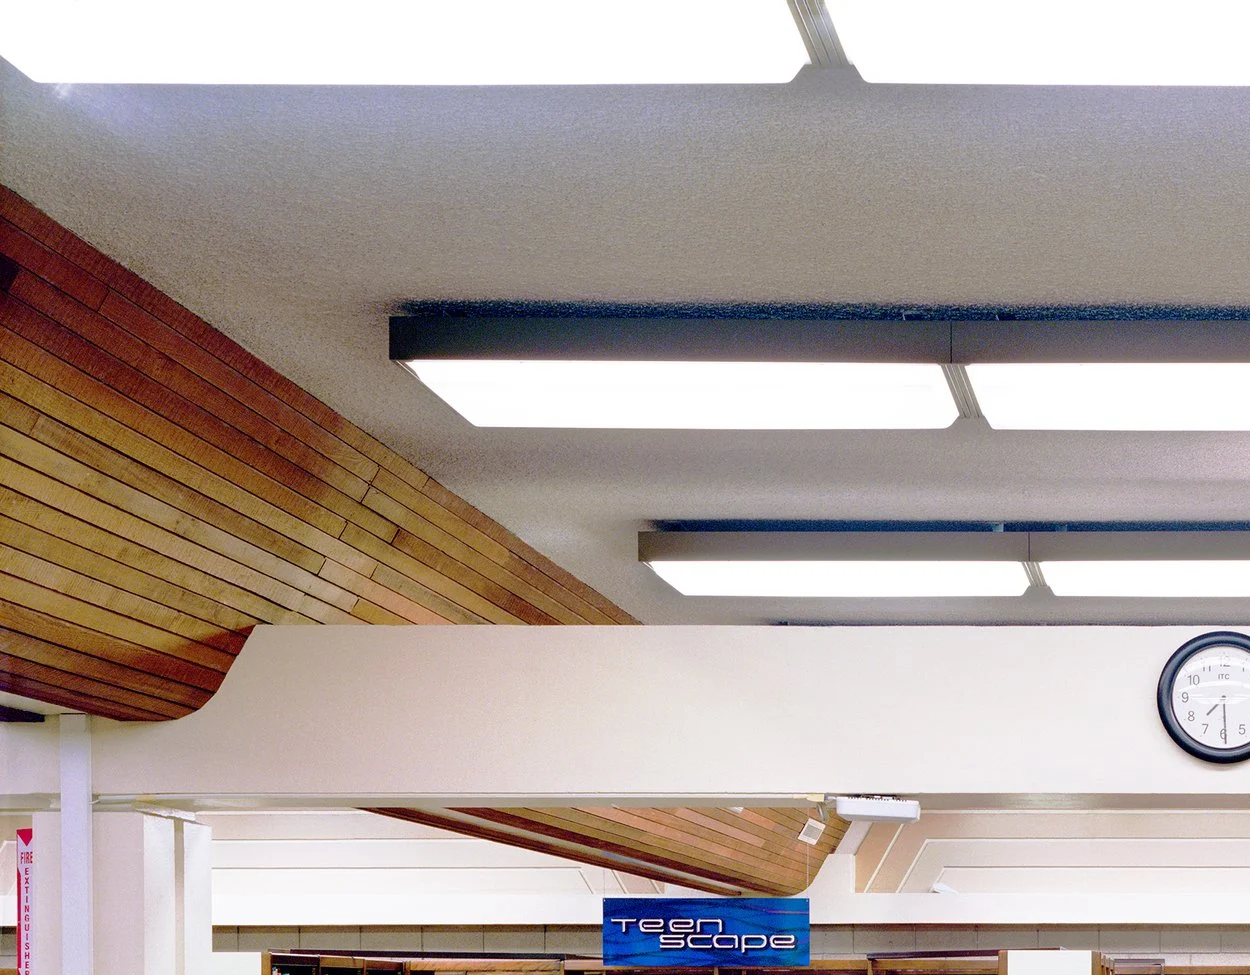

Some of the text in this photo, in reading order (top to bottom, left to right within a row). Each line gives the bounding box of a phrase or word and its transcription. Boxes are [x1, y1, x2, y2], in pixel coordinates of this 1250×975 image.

[1187, 674, 1200, 686] 10
[1181, 692, 1189, 703] 9
[1187, 711, 1195, 722] 8
[1202, 723, 1209, 735] 7
[1219, 728, 1228, 740] 6
[1238, 724, 1246, 735] 5
[20, 851, 33, 865] FIRE
[610, 917, 723, 934] Teen
[659, 933, 796, 954] scape
